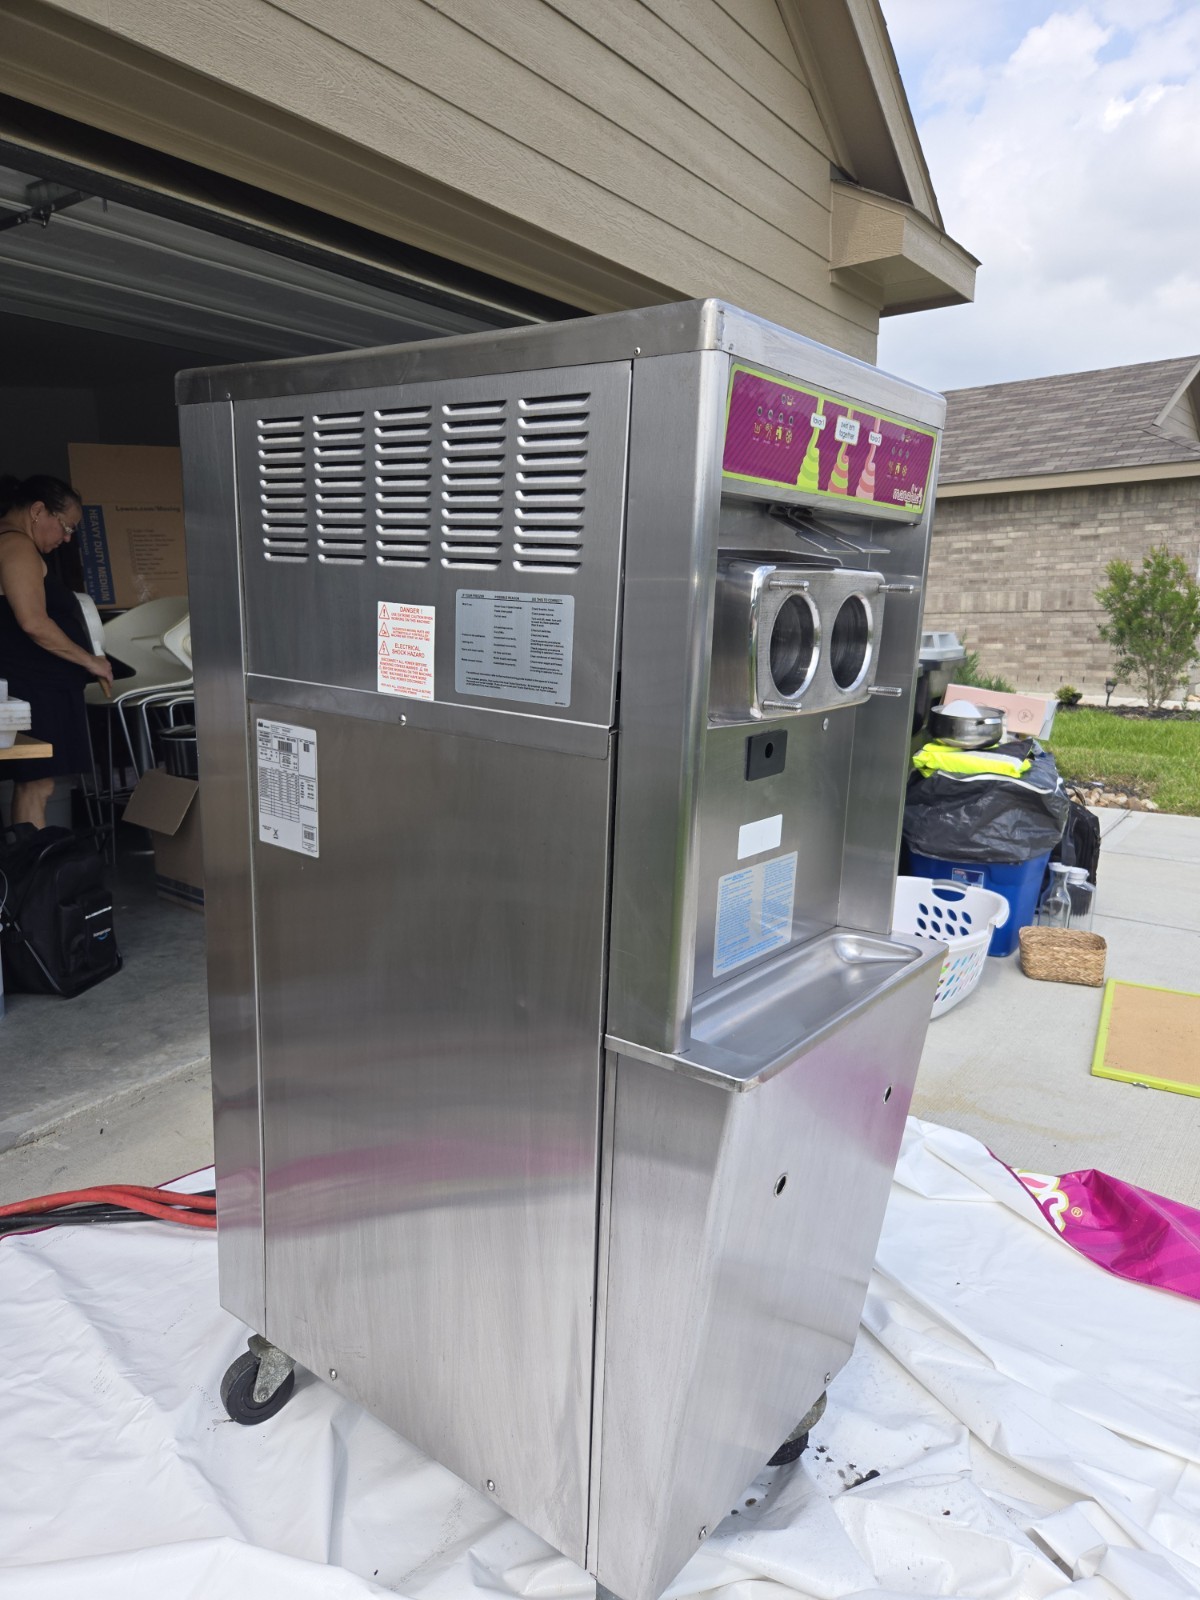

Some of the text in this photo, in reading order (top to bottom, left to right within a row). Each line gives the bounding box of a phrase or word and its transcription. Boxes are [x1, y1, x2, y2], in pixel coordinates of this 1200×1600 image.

[88, 508, 110, 601] HEAVY DUTY MEDIUM
[395, 643, 420, 651] ELECTRICAL
